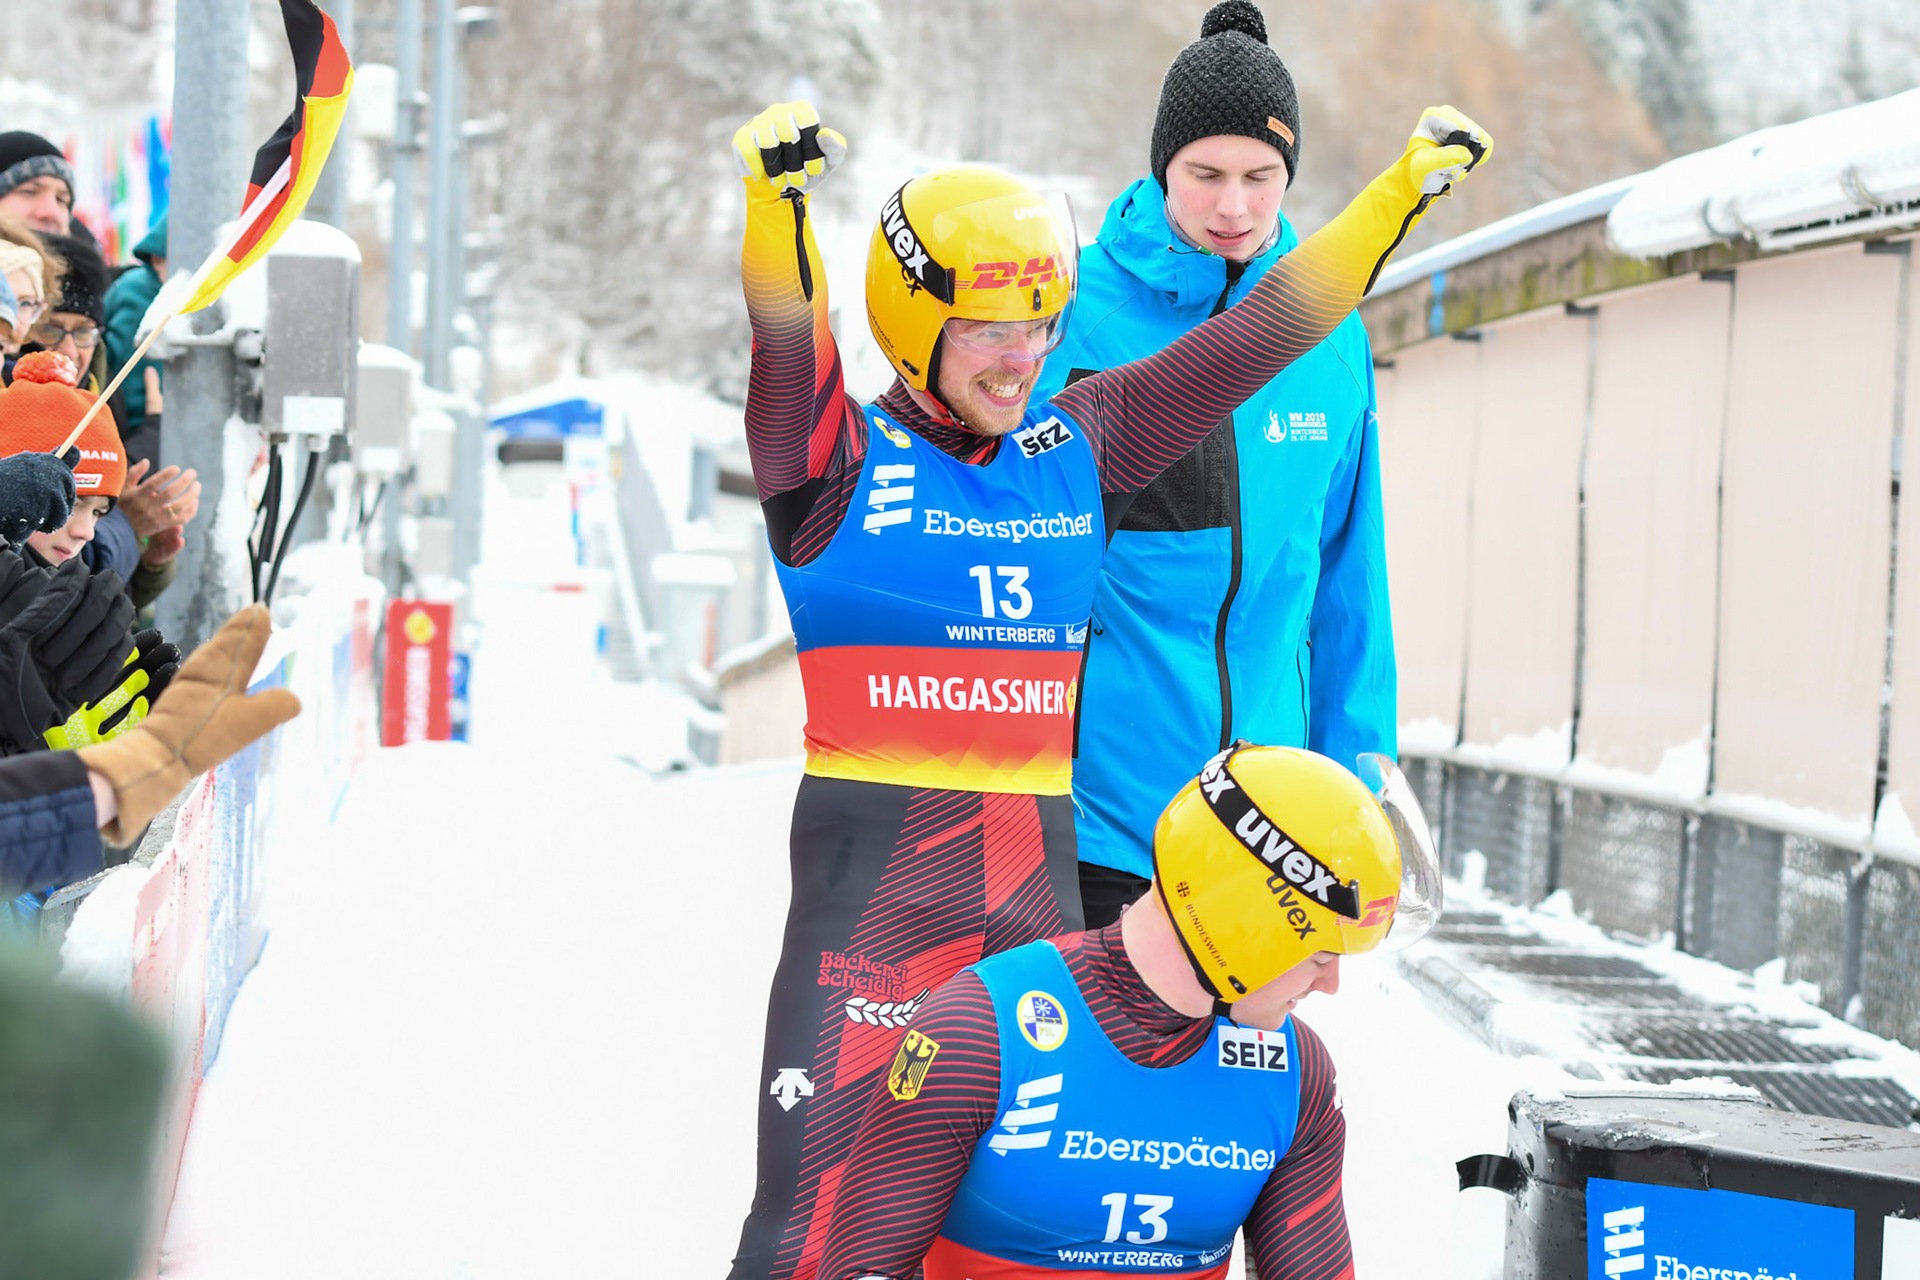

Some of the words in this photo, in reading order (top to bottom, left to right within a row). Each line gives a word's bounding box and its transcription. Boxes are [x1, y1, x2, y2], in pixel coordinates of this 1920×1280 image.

[882, 193, 929, 281] uvex
[1304, 412, 1326, 422] 2019
[923, 509, 1093, 543] Eberspächer
[968, 565, 1034, 620] 13
[945, 625, 1056, 644] WINTERBERG
[867, 674, 1065, 715] HARGASSNER
[1235, 807, 1336, 903] uvex
[1266, 873, 1317, 941] uvex
[1185, 903, 1227, 969] BUNDESWEHR
[817, 969, 905, 1002] Scheidig
[819, 951, 908, 983] Bäckerei
[1221, 1031, 1287, 1071] SEIZ
[1100, 1192, 1174, 1245] 13
[1057, 1249, 1184, 1268] WINTERBERG
